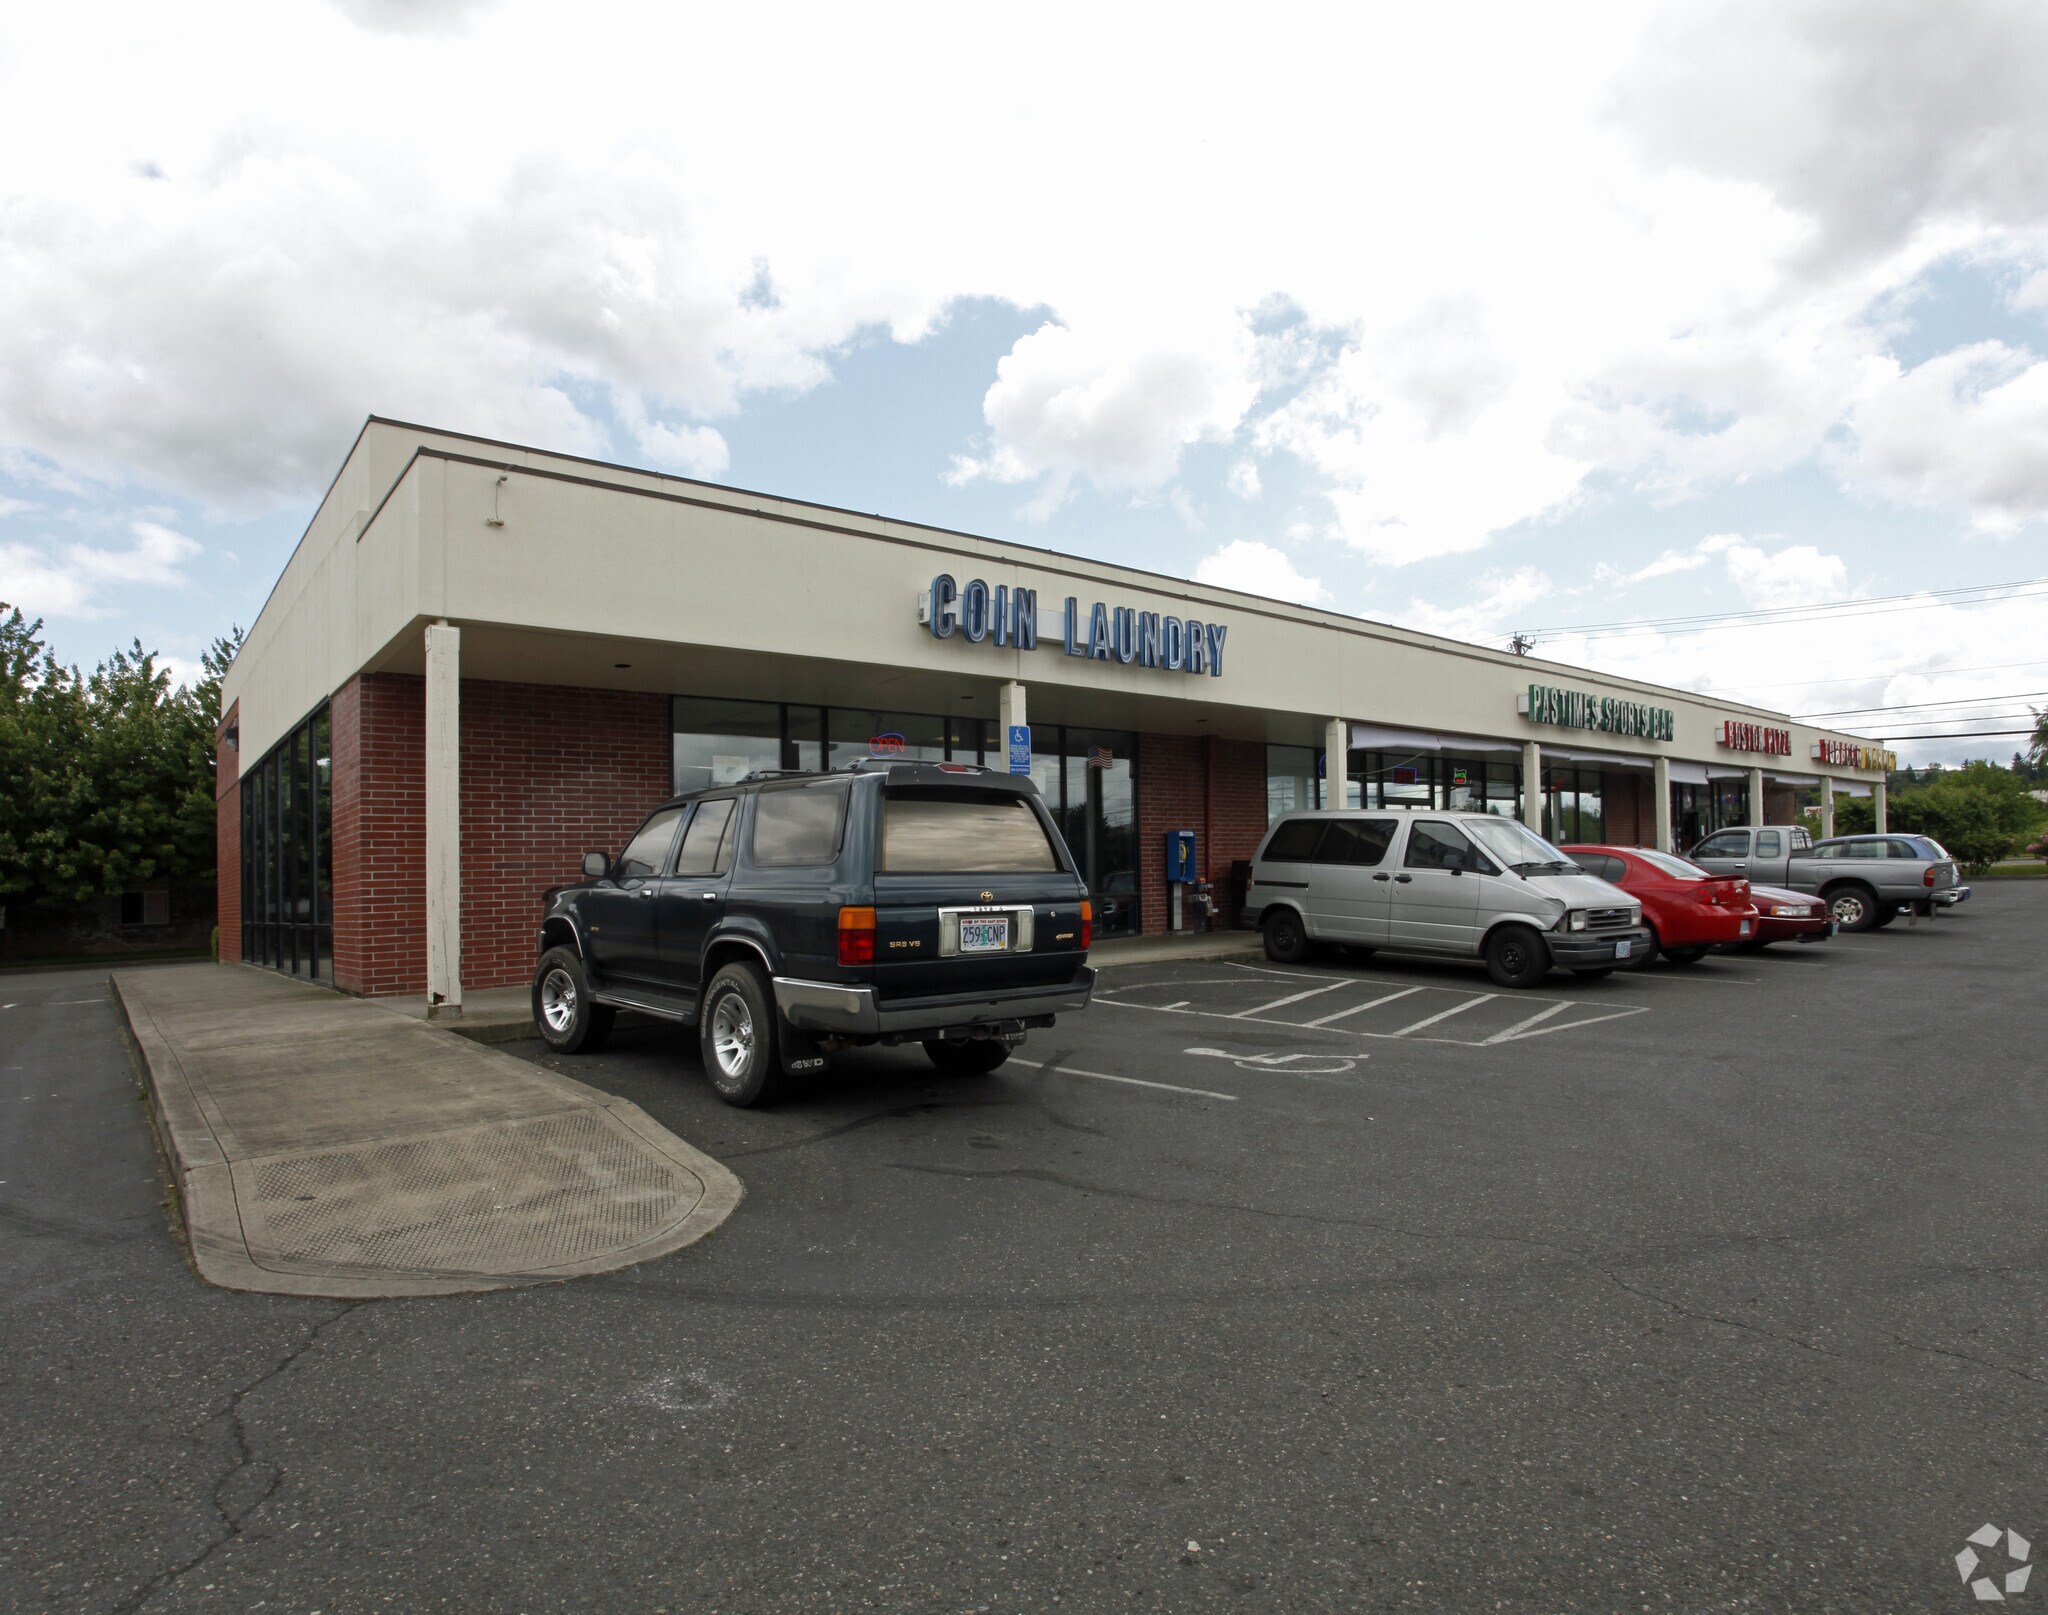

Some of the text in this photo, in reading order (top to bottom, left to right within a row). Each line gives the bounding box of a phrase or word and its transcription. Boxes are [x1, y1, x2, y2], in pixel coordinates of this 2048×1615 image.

[930, 574, 1228, 677] COIN LAUNDRY
[1529, 684, 1674, 742] PASTIMES SPORTS BAR
[869, 736, 905, 753] OPEN
[1724, 720, 1764, 753] BOSTON
[963, 925, 1005, 944] 259 CNP
[791, 1057, 824, 1069] 4WD
